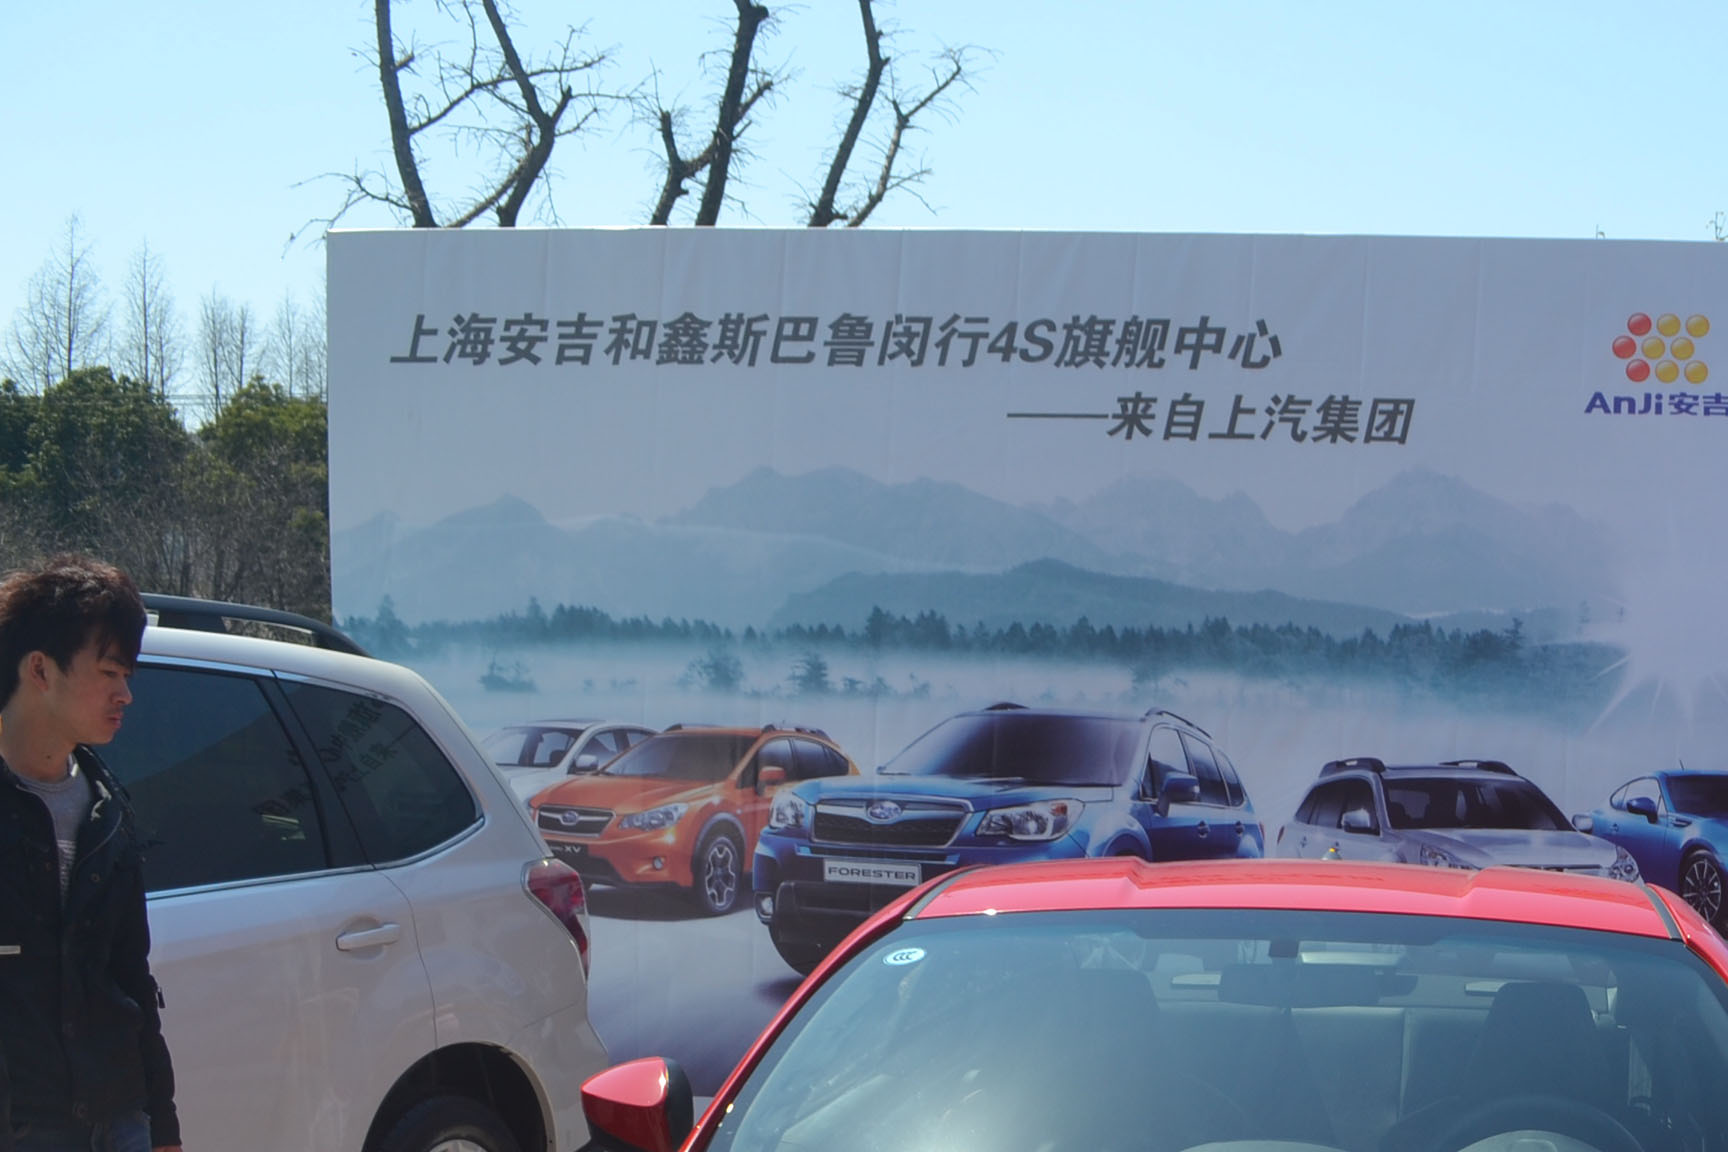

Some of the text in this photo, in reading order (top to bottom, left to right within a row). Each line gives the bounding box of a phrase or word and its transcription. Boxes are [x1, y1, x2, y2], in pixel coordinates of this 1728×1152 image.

[389, 310, 1284, 370] 上海安吉和鑫斯巴鲁闵行4S旗舰中心
[828, 866, 916, 881] FORESTER
